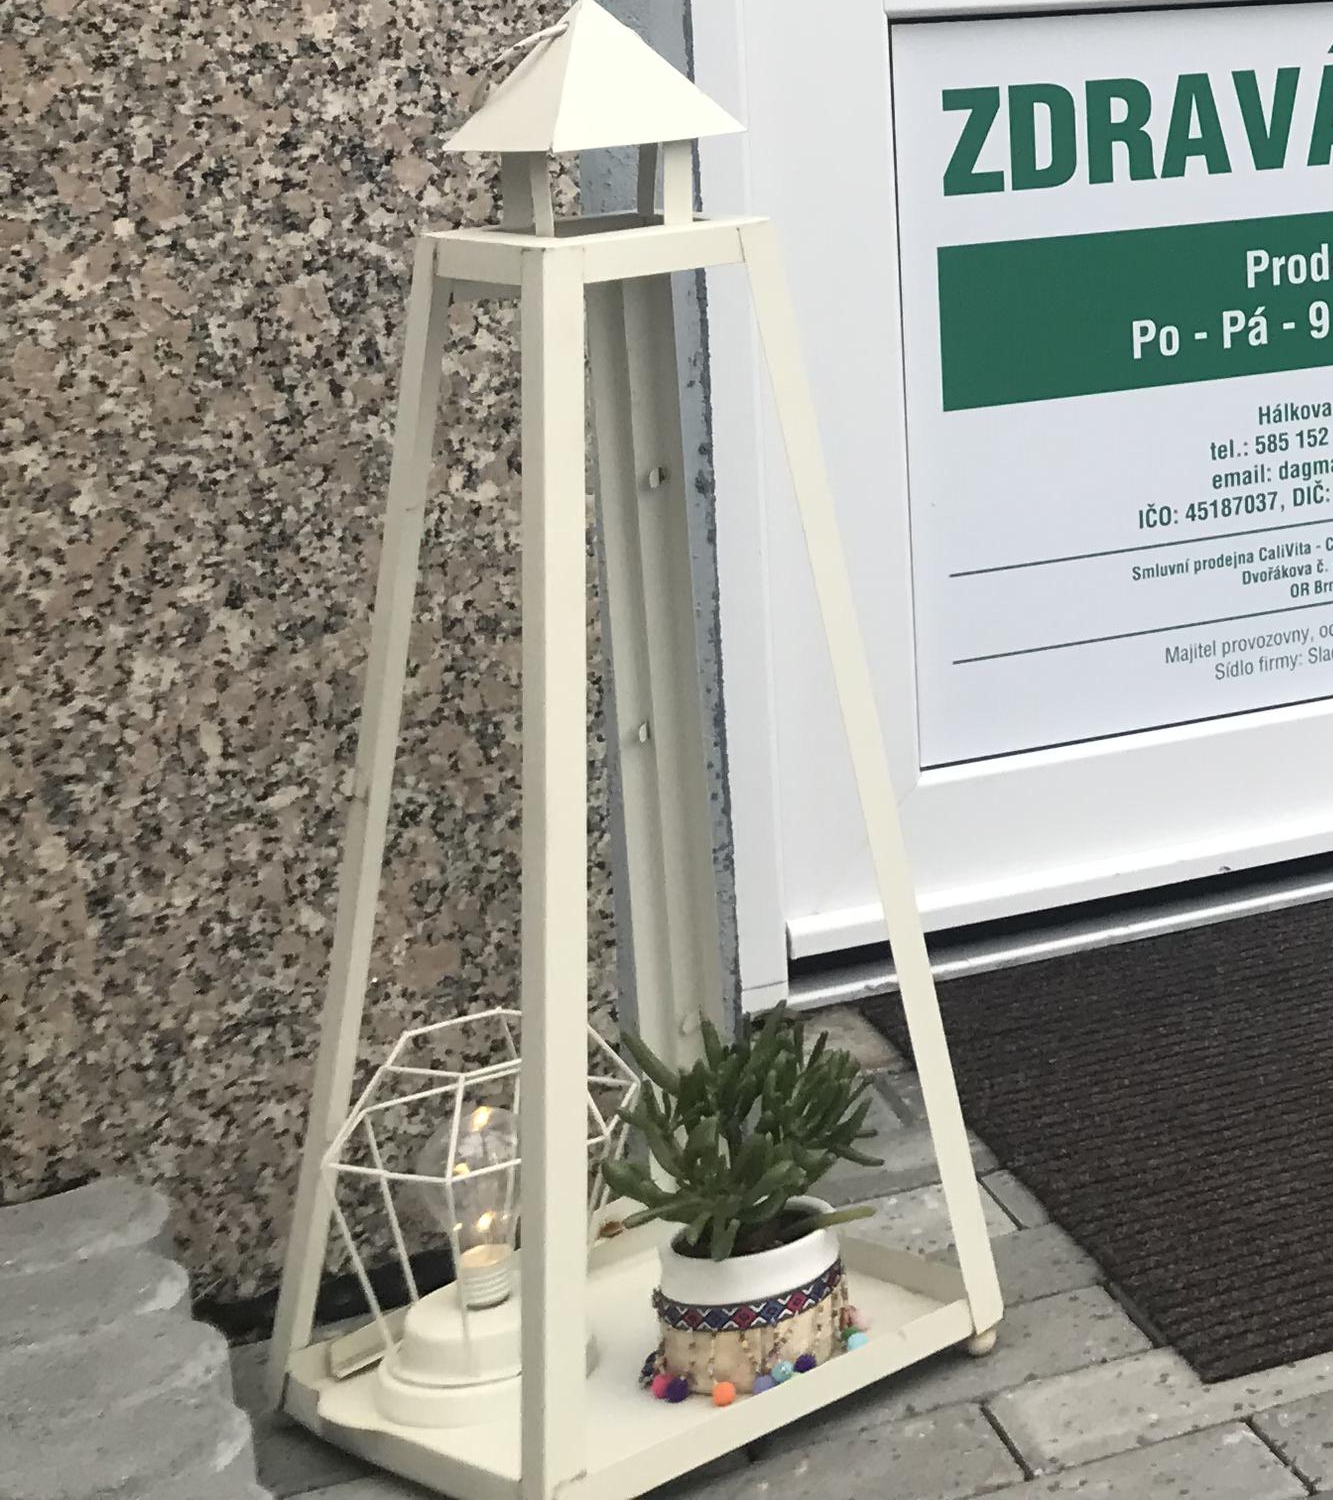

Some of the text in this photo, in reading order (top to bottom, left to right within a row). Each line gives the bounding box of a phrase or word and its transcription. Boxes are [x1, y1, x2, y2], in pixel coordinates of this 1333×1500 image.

[1132, 319, 1180, 360] Po
[1222, 305, 1268, 349] Pá
[1258, 401, 1332, 426] Hálkova
[1209, 438, 1249, 461] tel.:
[1255, 431, 1290, 455] 585
[1295, 426, 1329, 449] 152
[1212, 463, 1272, 490] email:
[1138, 503, 1179, 530] IČO:
[1185, 490, 1285, 522] 45187037,
[1292, 479, 1330, 508] DIČ:
[1131, 558, 1190, 582] Smluvní
[1193, 551, 1255, 575] prodejna
[1258, 541, 1312, 562] CaliVita
[1242, 563, 1313, 586] Dvořákova
[1316, 558, 1329, 574] č.
